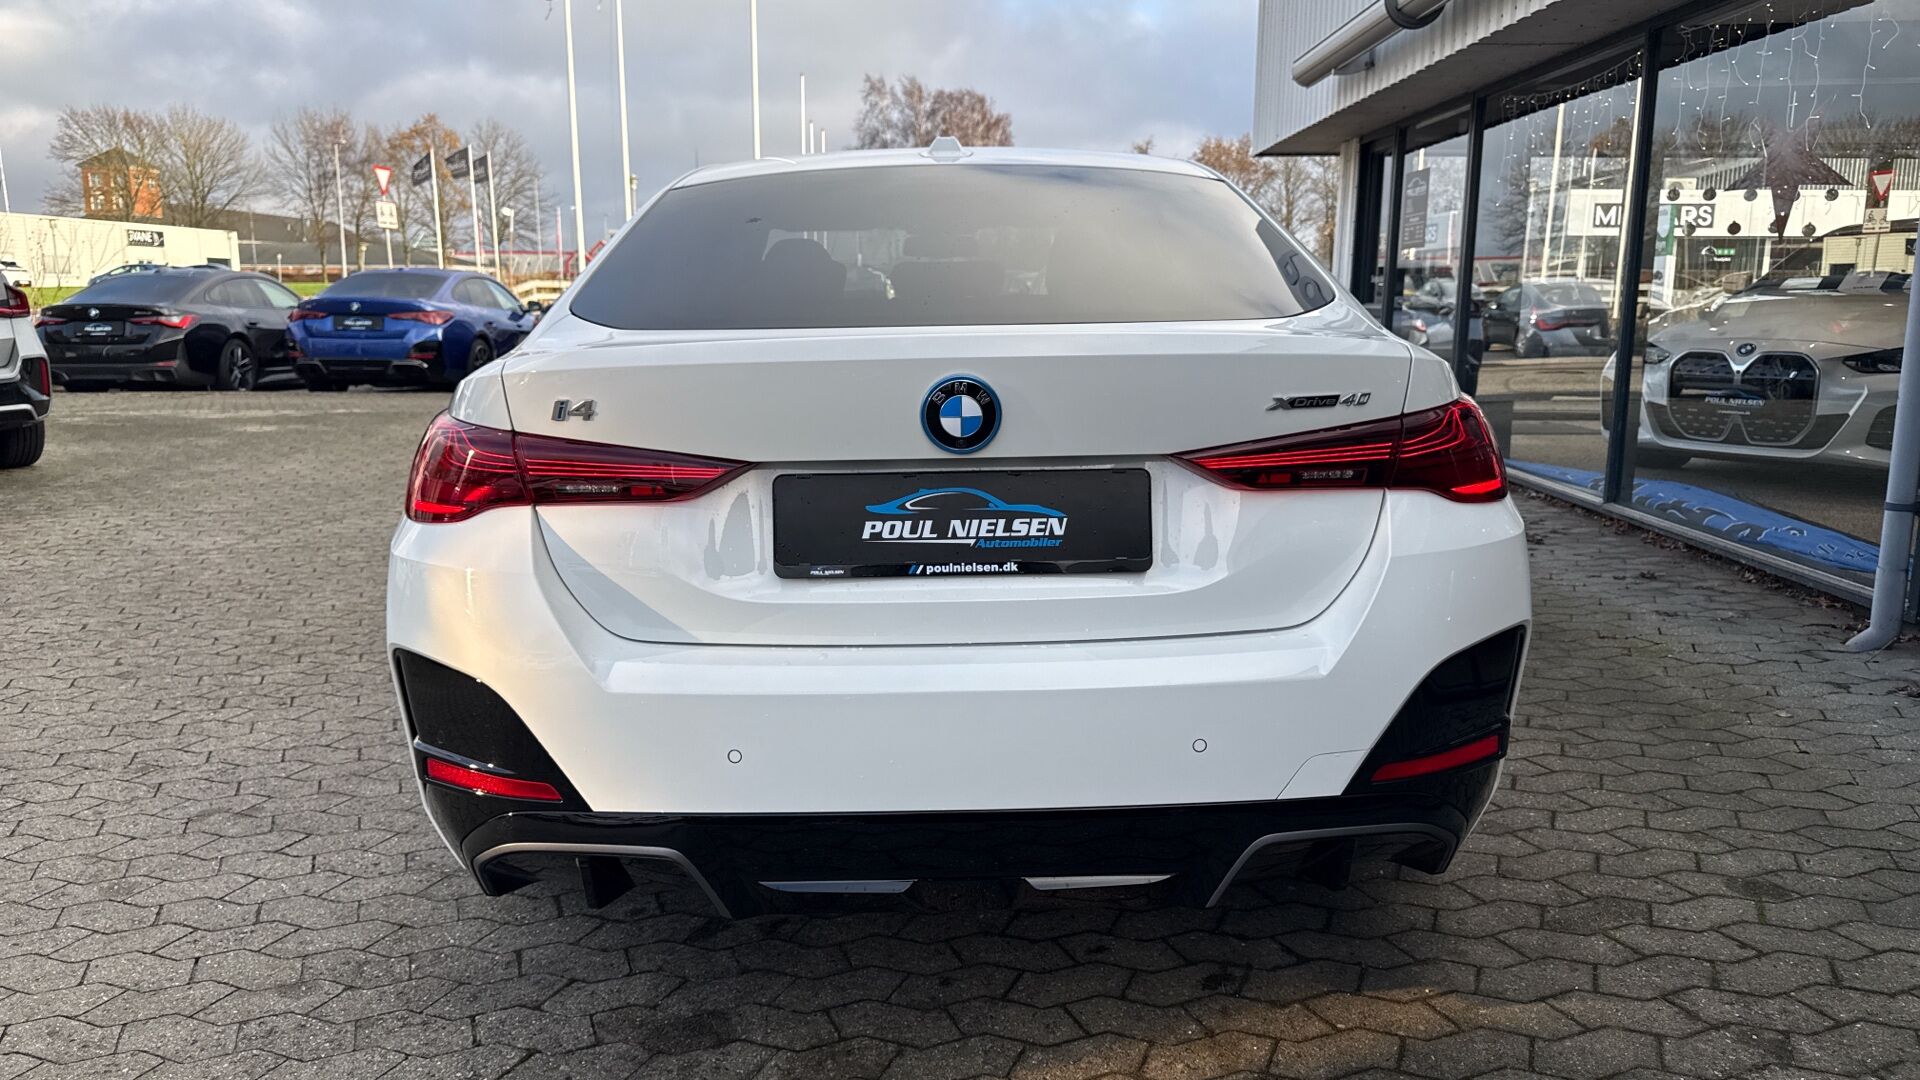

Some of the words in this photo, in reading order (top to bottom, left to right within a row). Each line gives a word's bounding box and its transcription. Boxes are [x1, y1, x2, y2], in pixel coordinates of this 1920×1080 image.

[932, 382, 991, 406] BMW
[551, 399, 595, 421] i4
[861, 519, 938, 539] POUL
[947, 517, 1068, 538] NIELSEN
[976, 537, 1063, 549] Automobiler
[926, 562, 1018, 574] poulnielsen.dk
